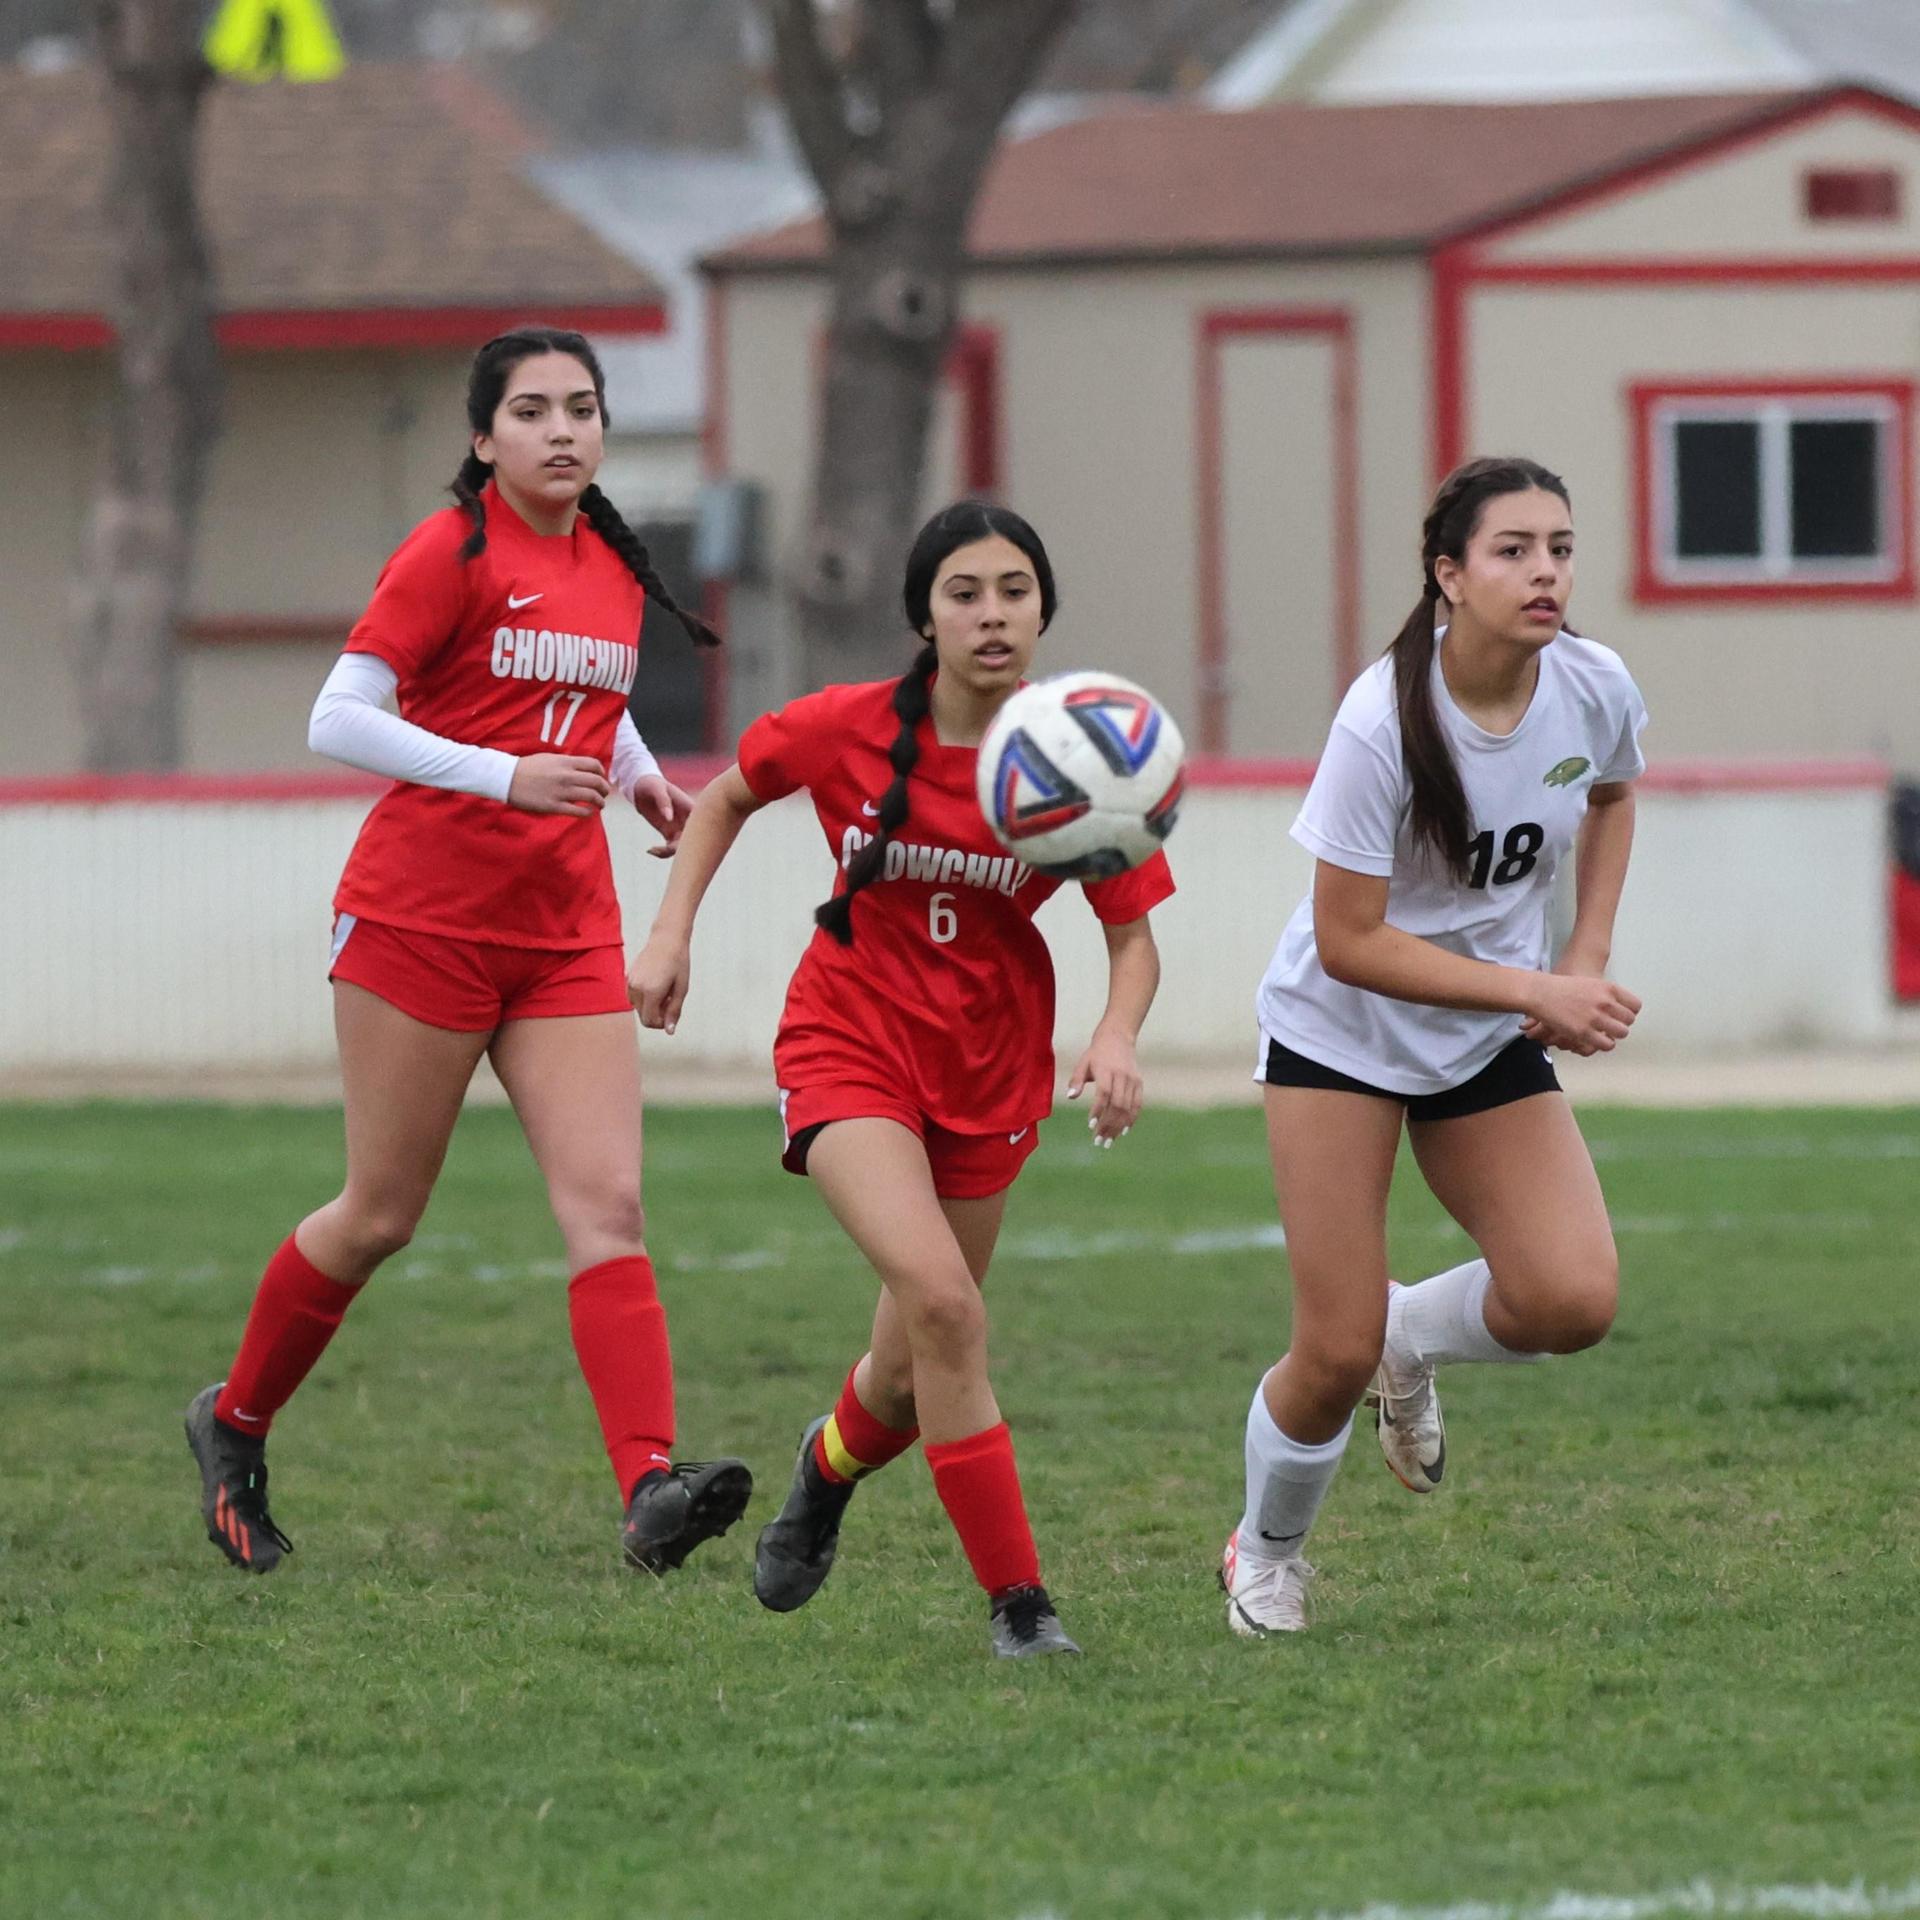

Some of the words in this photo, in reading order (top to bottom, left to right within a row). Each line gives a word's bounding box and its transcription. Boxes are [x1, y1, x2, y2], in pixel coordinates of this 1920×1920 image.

[540, 690, 587, 747] 17
[1467, 822, 1544, 889] 18
[929, 892, 957, 943] 6
